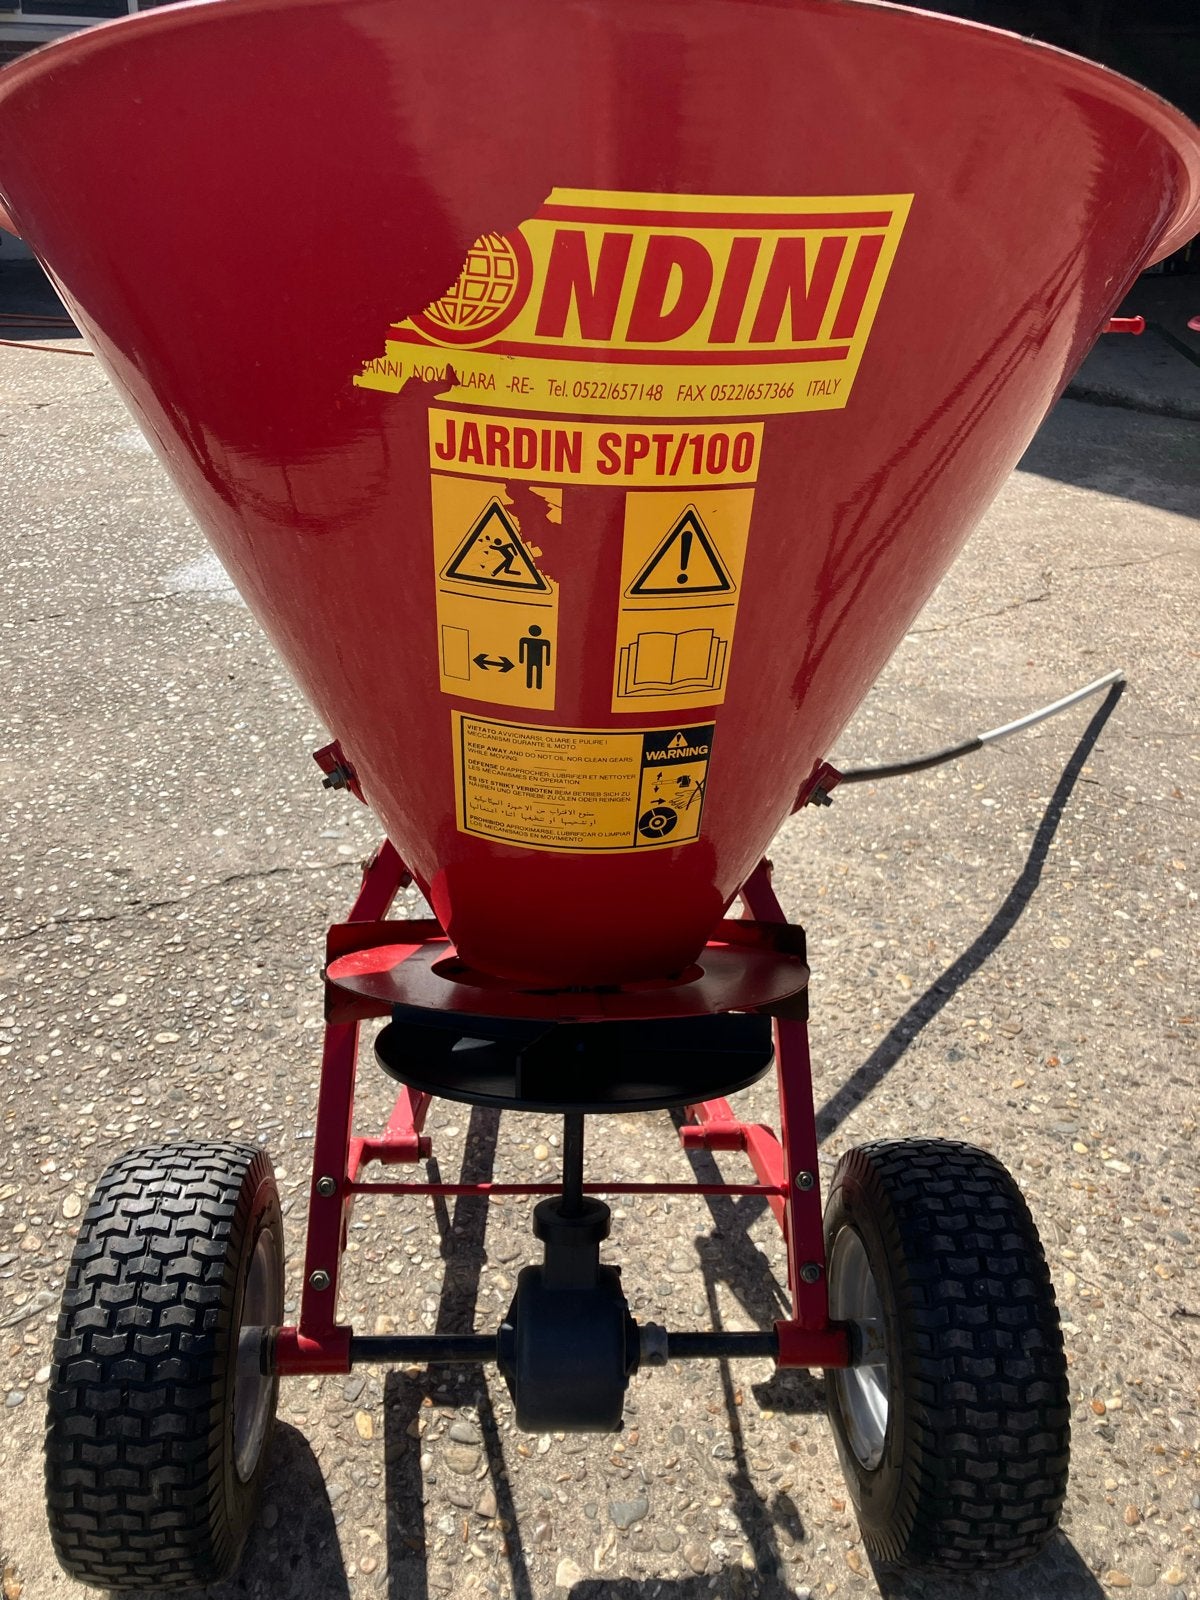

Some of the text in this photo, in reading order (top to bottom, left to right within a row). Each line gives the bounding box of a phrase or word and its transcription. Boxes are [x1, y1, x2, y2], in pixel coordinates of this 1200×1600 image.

[506, 376, 534, 394] -RE-
[548, 379, 569, 397] Tel.
[572, 381, 663, 401] 0522/657148
[676, 384, 707, 402] FAX
[710, 382, 795, 401] 0522/657366
[806, 378, 842, 397] ITALY
[435, 419, 756, 476] JARDIN SPT/100
[467, 724, 496, 735] VIETATO
[467, 741, 485, 750] KEEP
[486, 746, 507, 754] AWAY
[512, 738, 545, 748] DURANTE
[467, 747, 518, 762] WHILE MOVING
[646, 745, 709, 761] WARNING
[468, 765, 482, 773] LES
[490, 780, 514, 790] STRIKT
[516, 785, 553, 795] VERBOTEN
[496, 787, 512, 795] UND
[470, 815, 505, 827] PROHIBIDO
[470, 820, 483, 829] LOS
[540, 834, 583, 843] MOVIMIENTO
